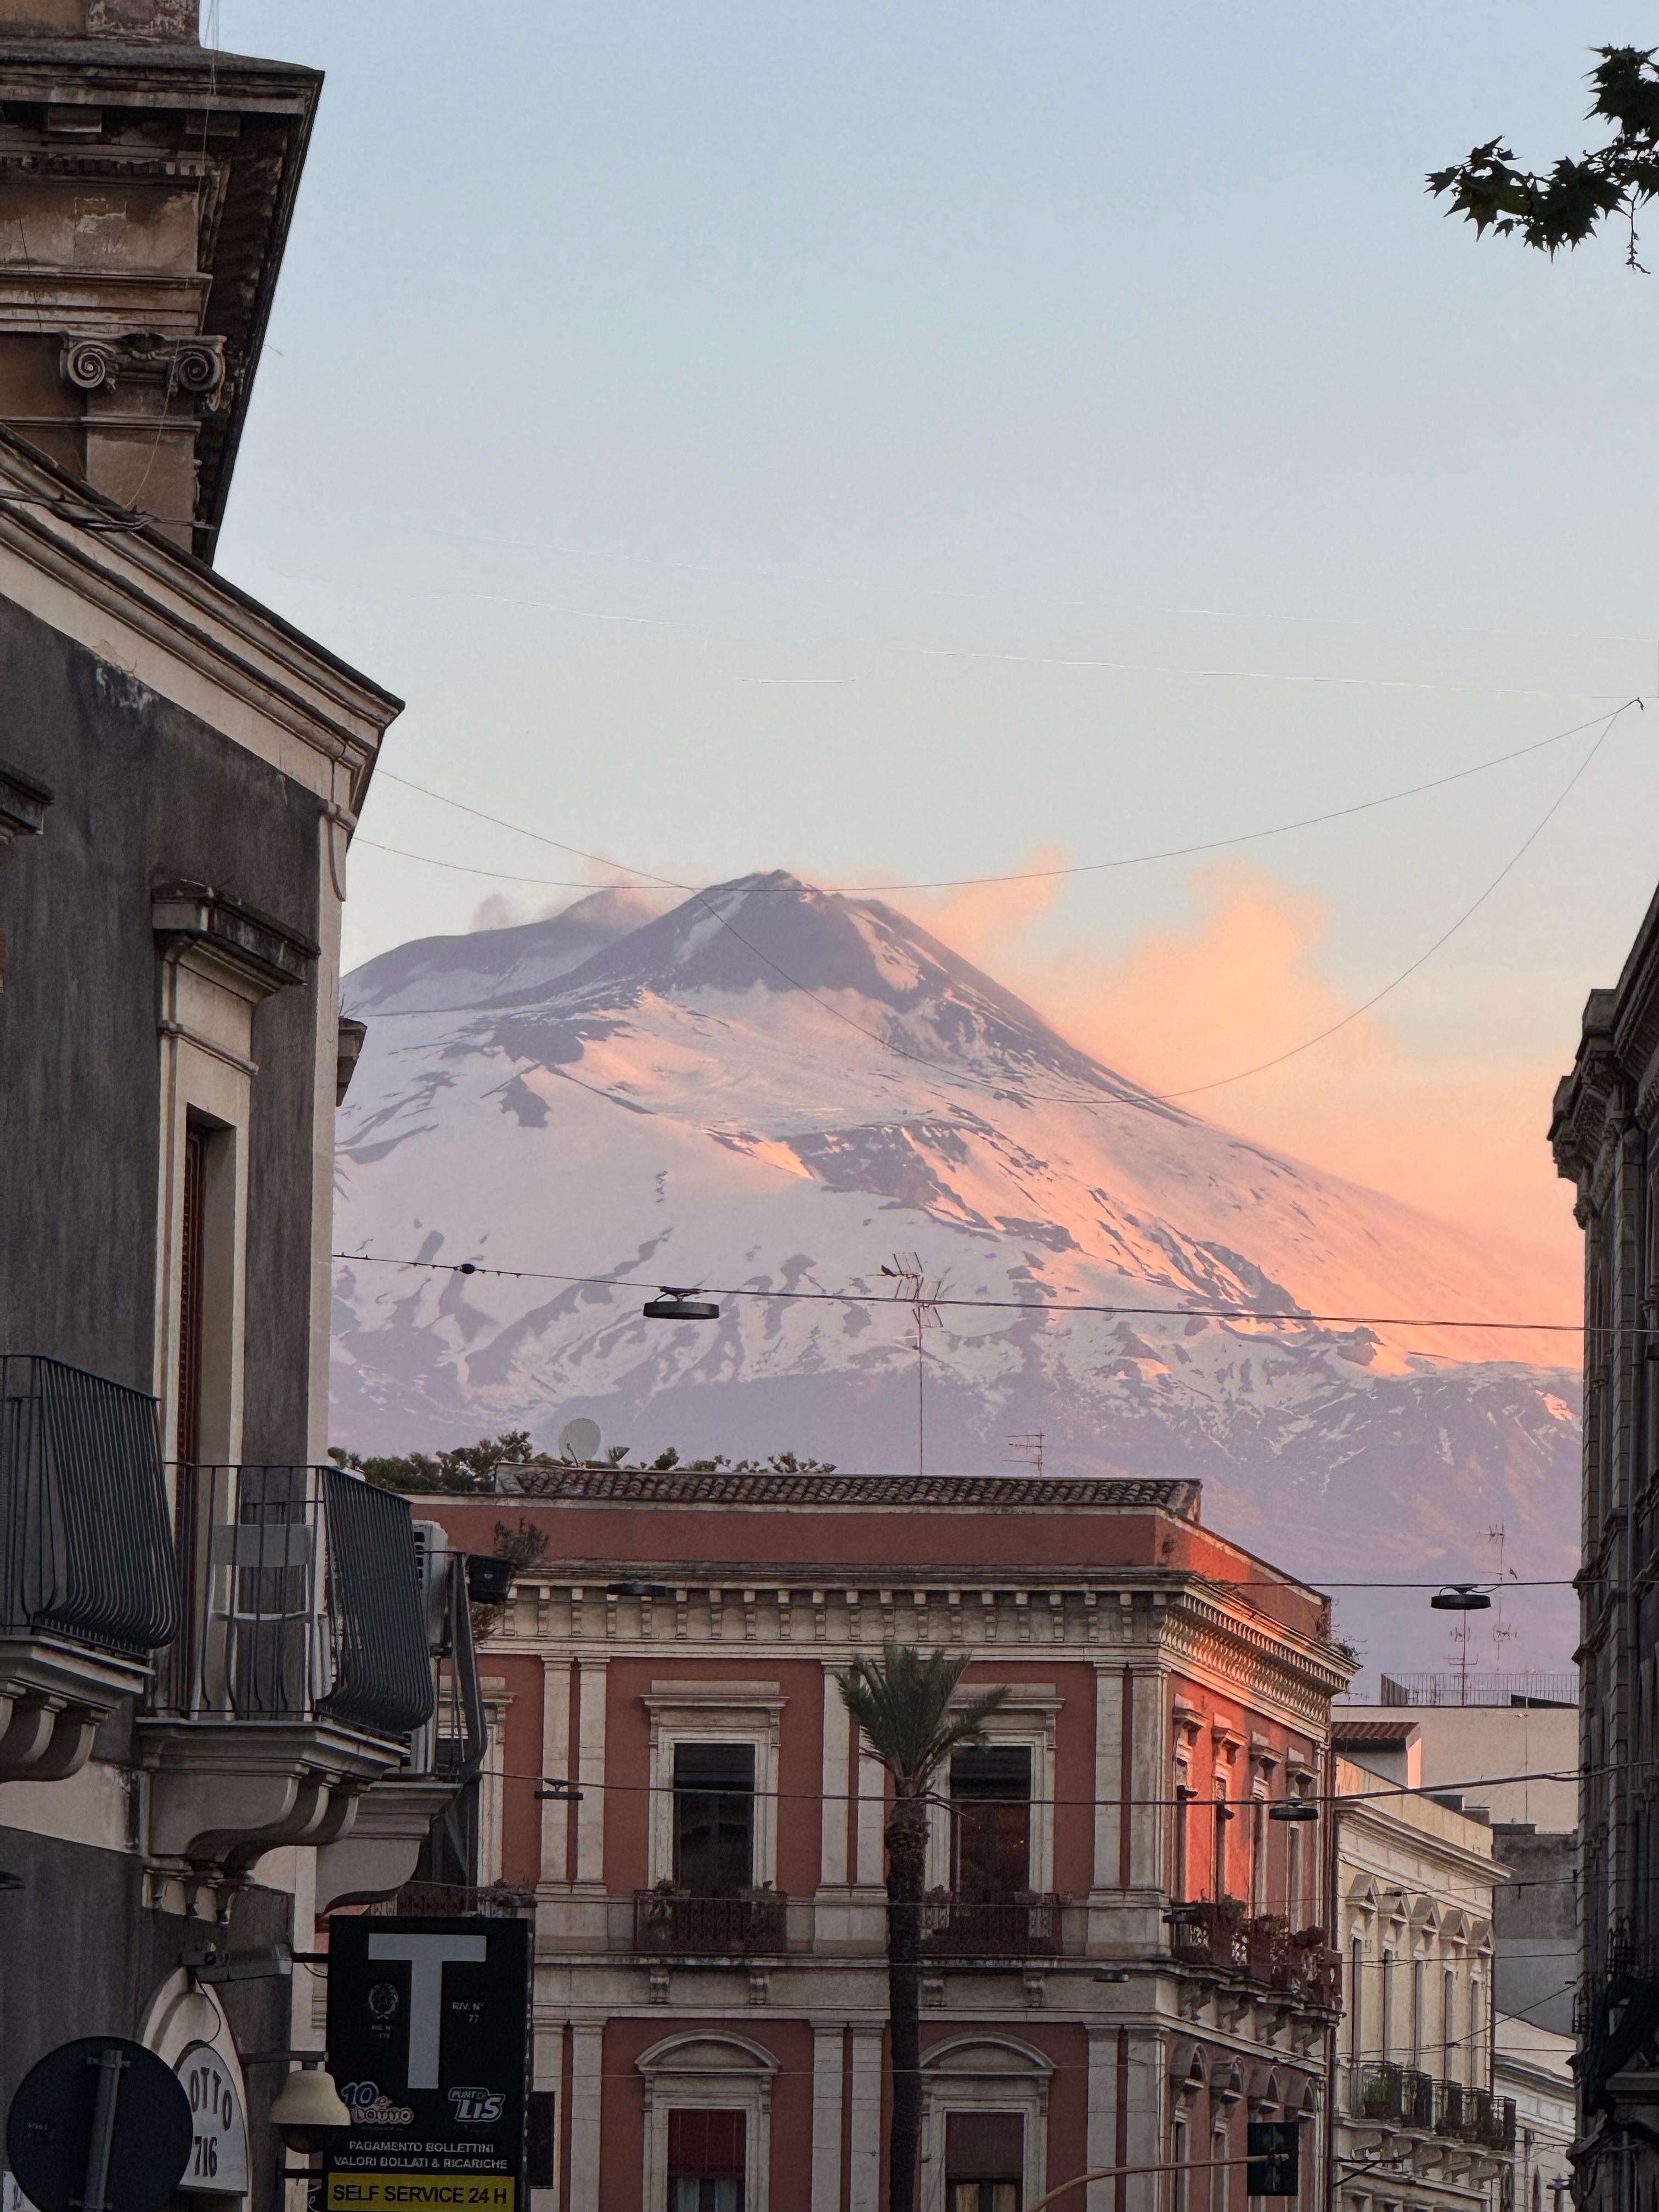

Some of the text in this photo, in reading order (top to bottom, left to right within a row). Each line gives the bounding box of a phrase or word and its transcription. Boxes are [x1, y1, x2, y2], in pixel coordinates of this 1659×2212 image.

[368, 1933, 487, 2089] T
[452, 2090, 486, 2100] PUNTO
[354, 2107, 414, 2124] LOTTO
[349, 2141, 494, 2153] PAGAMENTO BOLLETTINI
[194, 2136, 218, 2177] 716
[334, 2155, 507, 2169] VALORI BOLLATI & RICARICHE
[332, 2185, 380, 2200] SELF
[384, 2186, 465, 2203] SERVICE
[468, 2187, 489, 2204] 24
[493, 2188, 507, 2204] H
